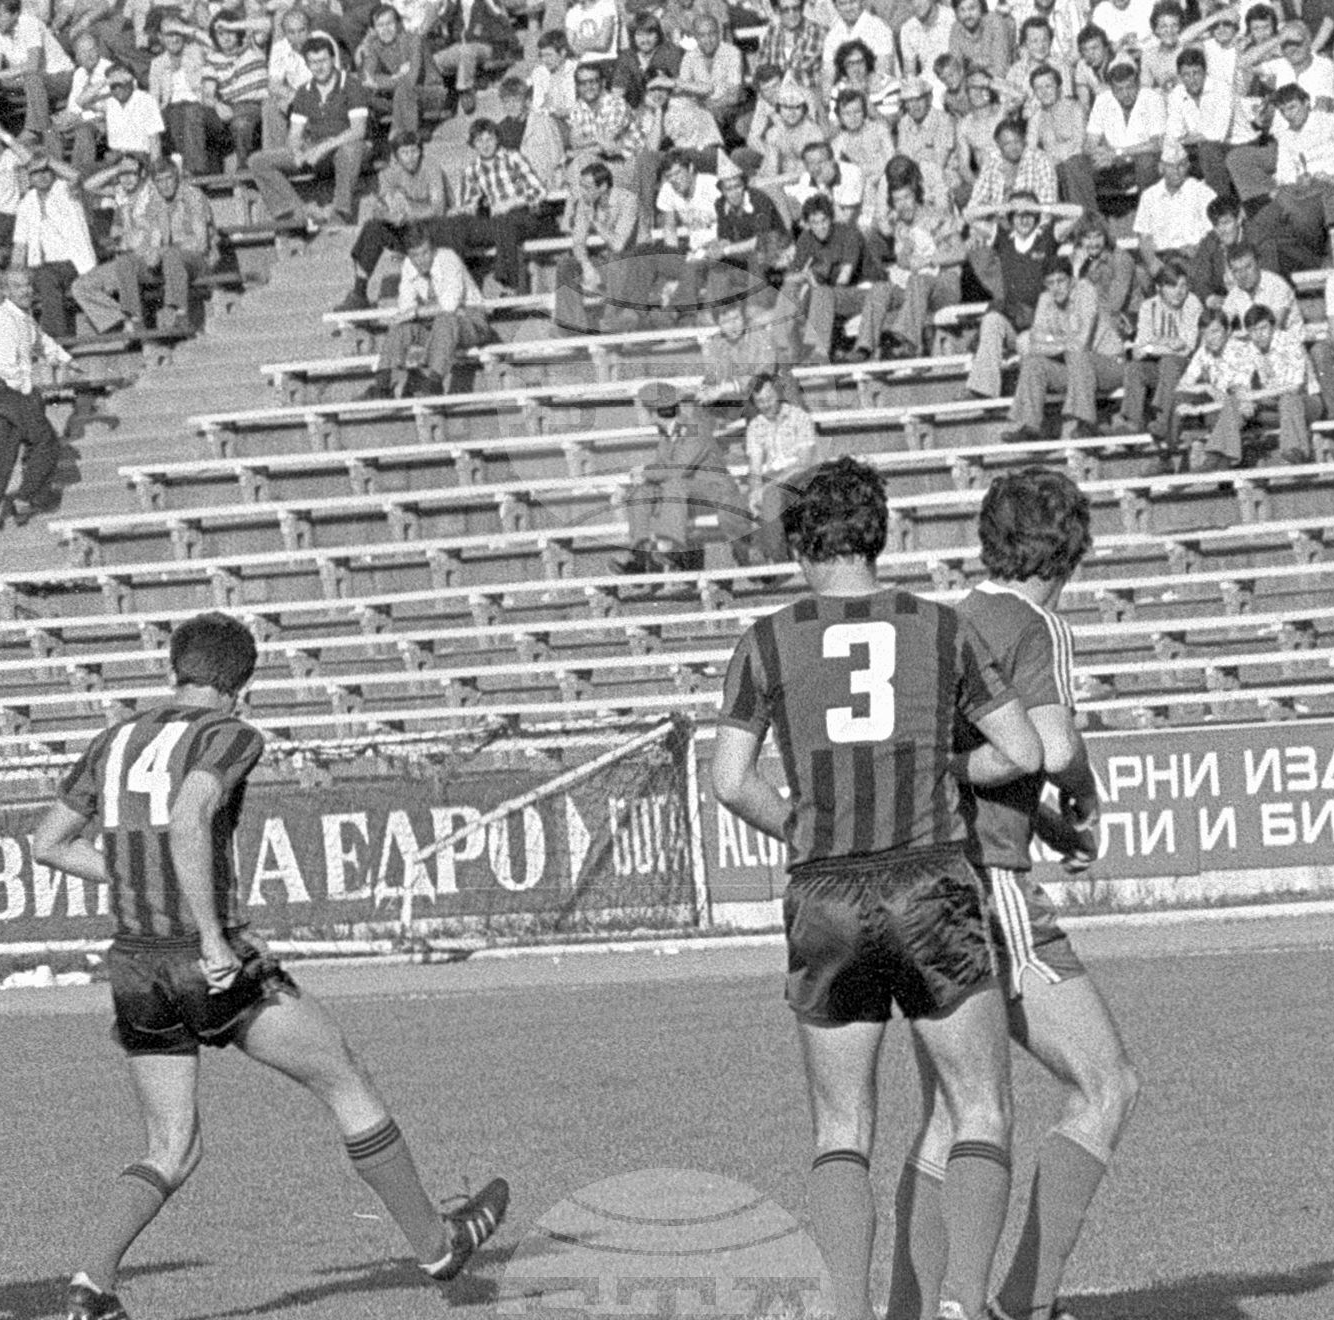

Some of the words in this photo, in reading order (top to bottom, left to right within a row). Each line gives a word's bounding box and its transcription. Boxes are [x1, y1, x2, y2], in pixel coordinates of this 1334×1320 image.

[822, 621, 896, 743] 3
[103, 721, 190, 828] 14
[1199, 806, 1237, 850] И
